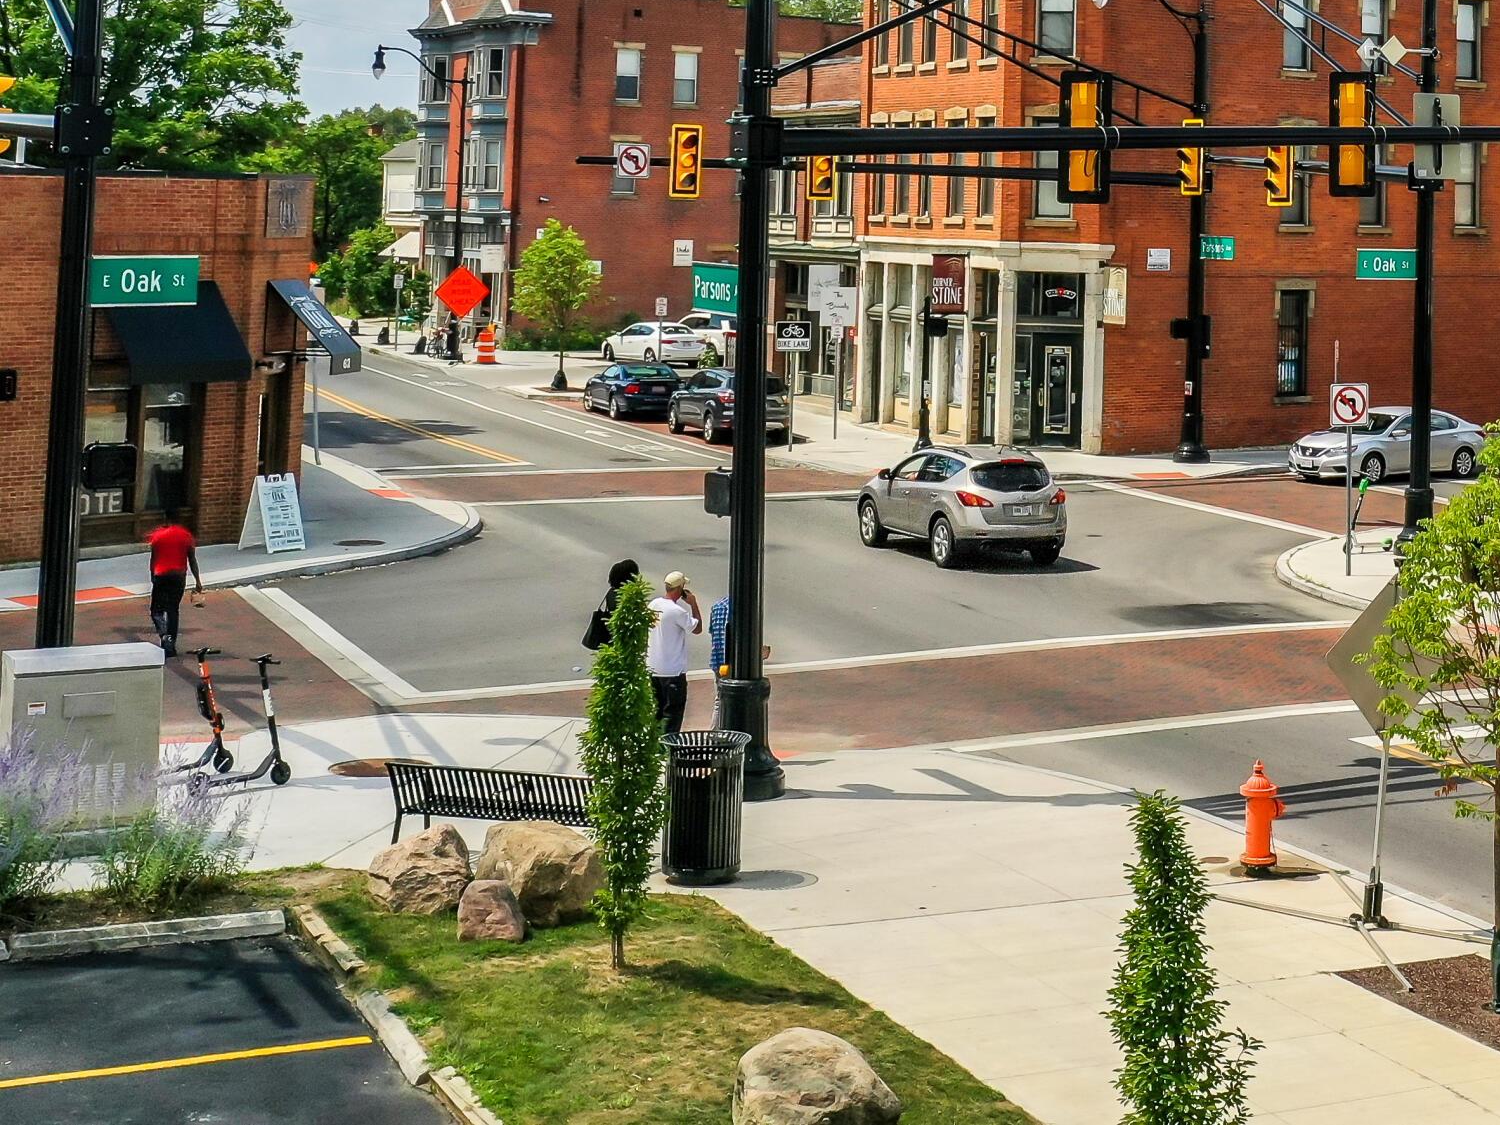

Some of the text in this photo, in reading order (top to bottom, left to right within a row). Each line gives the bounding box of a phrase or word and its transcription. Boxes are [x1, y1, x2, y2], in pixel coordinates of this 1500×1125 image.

[1363, 257, 1409, 272] E Oak St
[103, 269, 185, 293] E Oak St
[694, 275, 731, 302] Parsons
[931, 286, 963, 305] STONE
[1103, 297, 1125, 316] STONE
[777, 339, 809, 348] BIKE LANE
